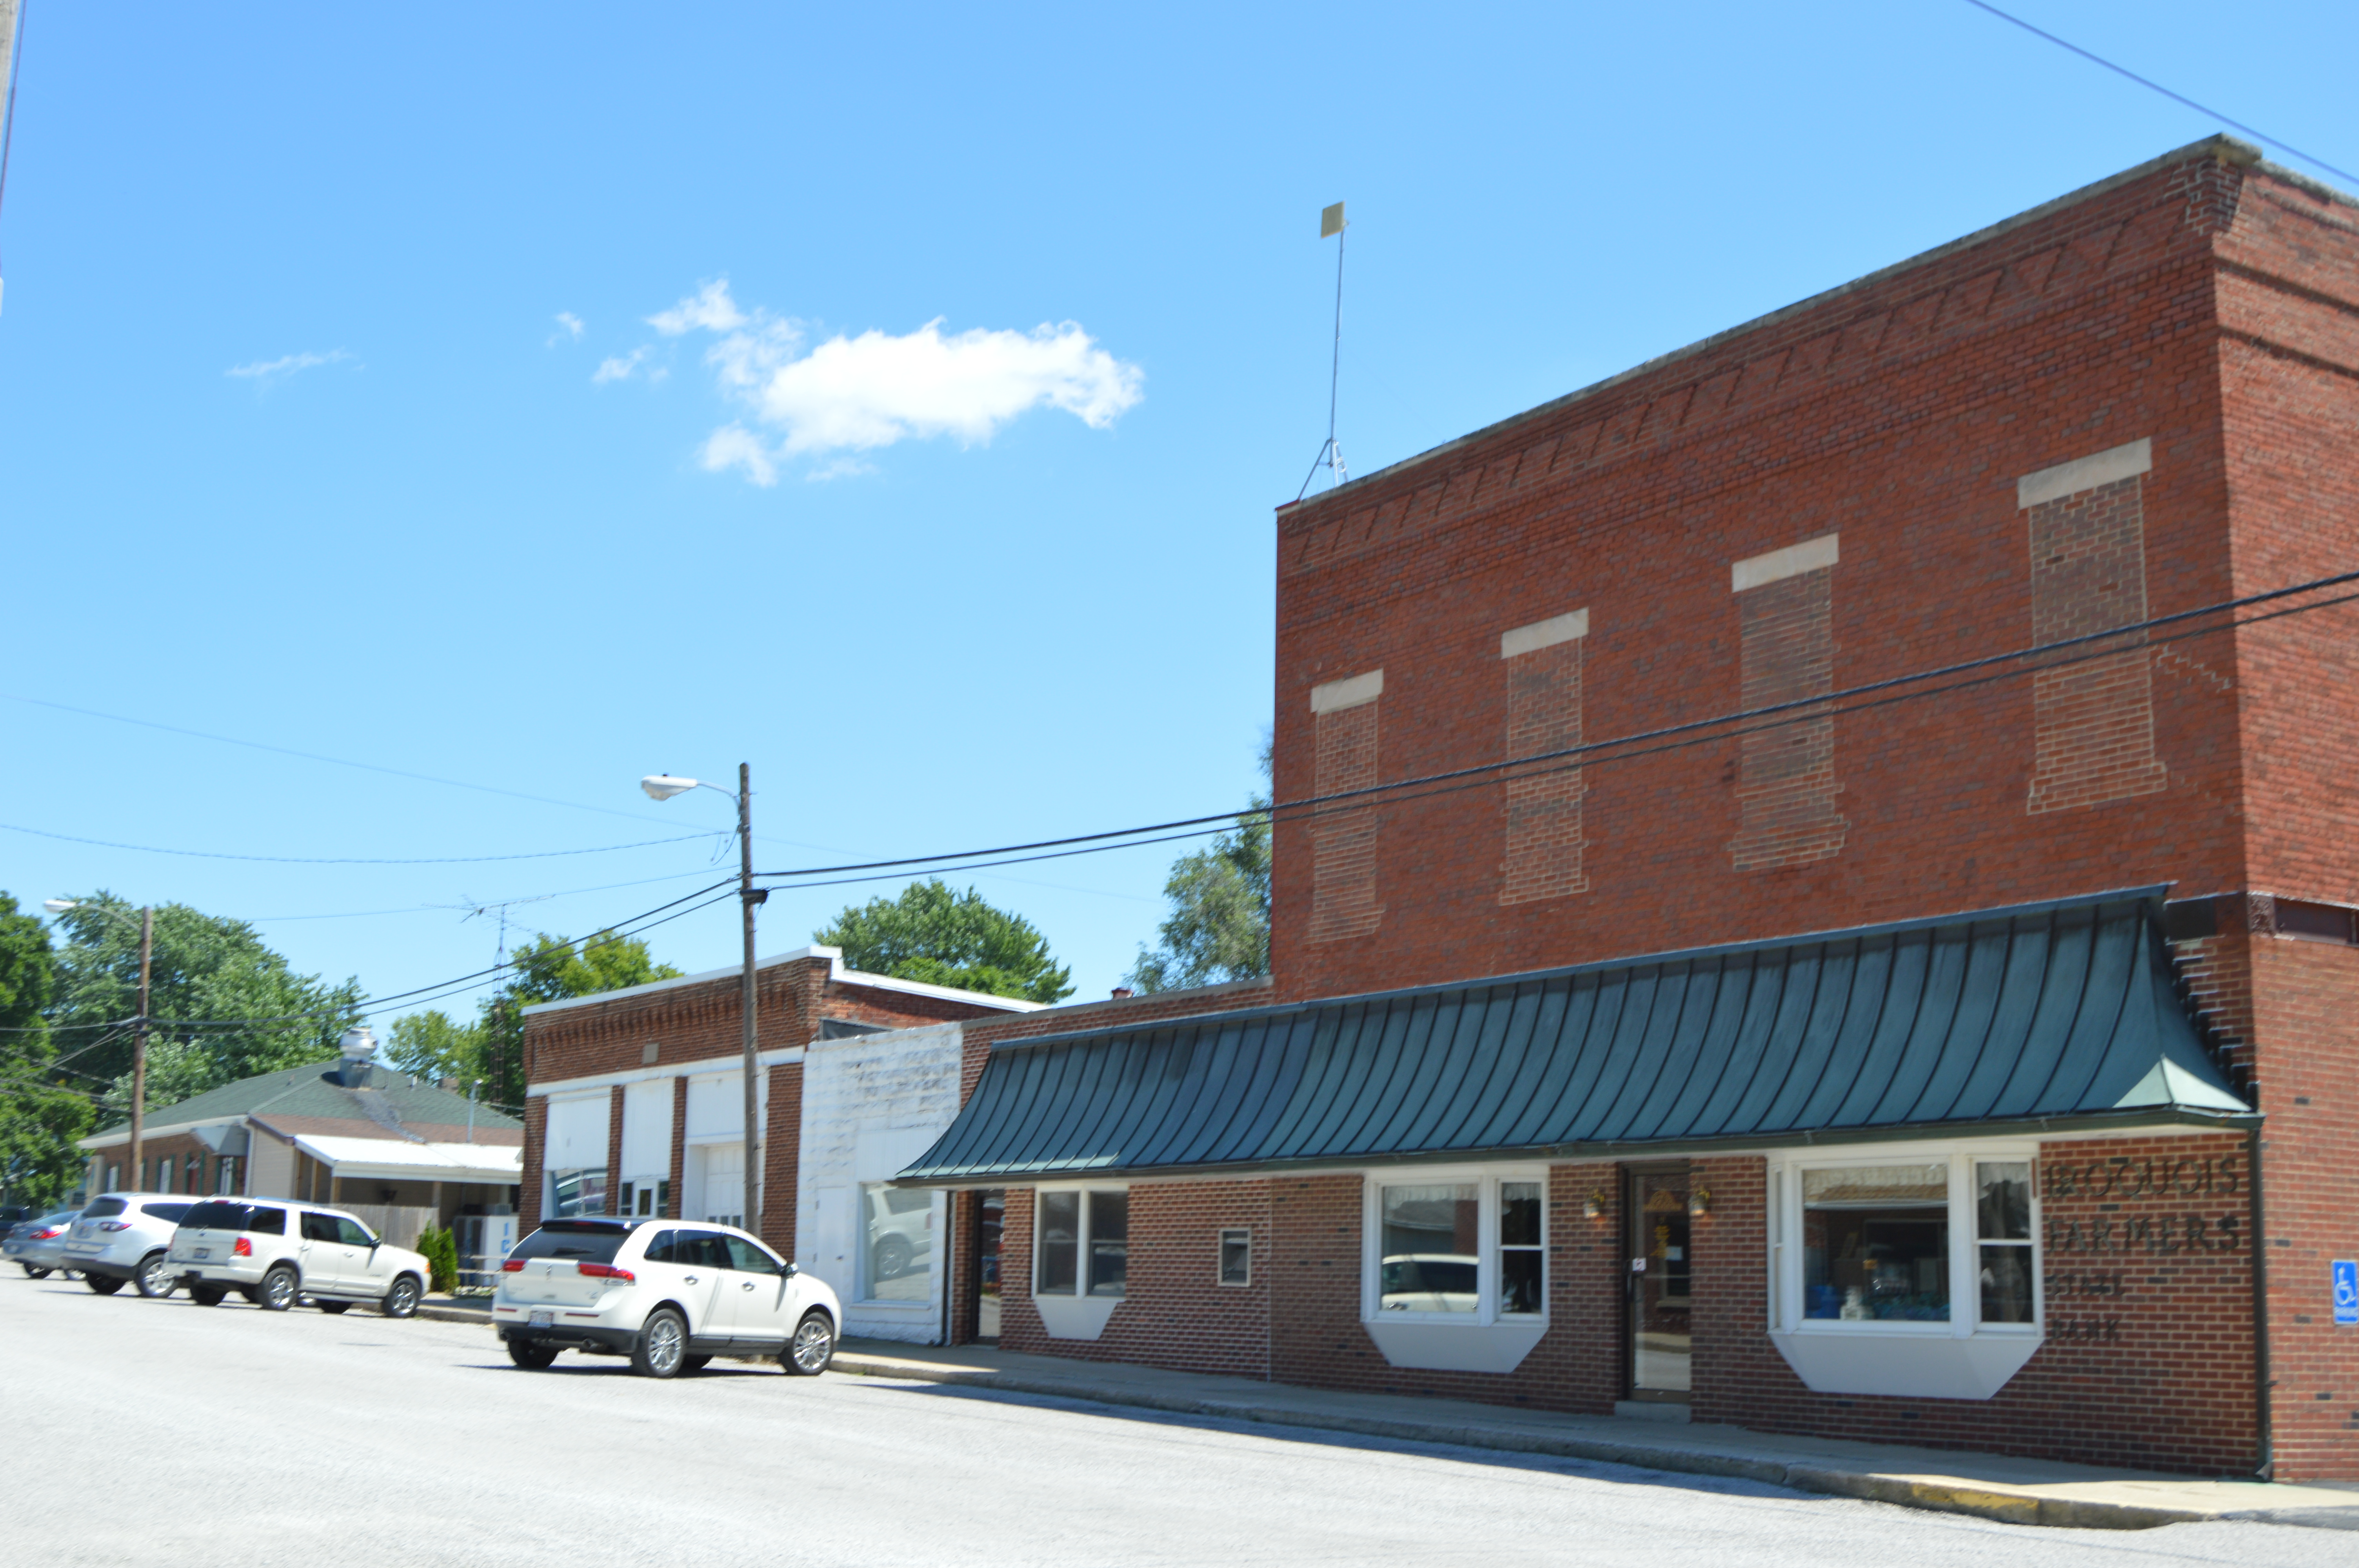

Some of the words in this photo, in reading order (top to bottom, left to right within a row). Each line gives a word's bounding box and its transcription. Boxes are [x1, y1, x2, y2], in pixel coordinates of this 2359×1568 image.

[2047, 1158, 2237, 1200] IROQUOIS
[500, 1222, 511, 1269] IC
[2048, 1216, 2239, 1252] FARMERS
[2045, 1274, 2126, 1296] STATE
[2051, 1319, 2120, 1340] BANK
